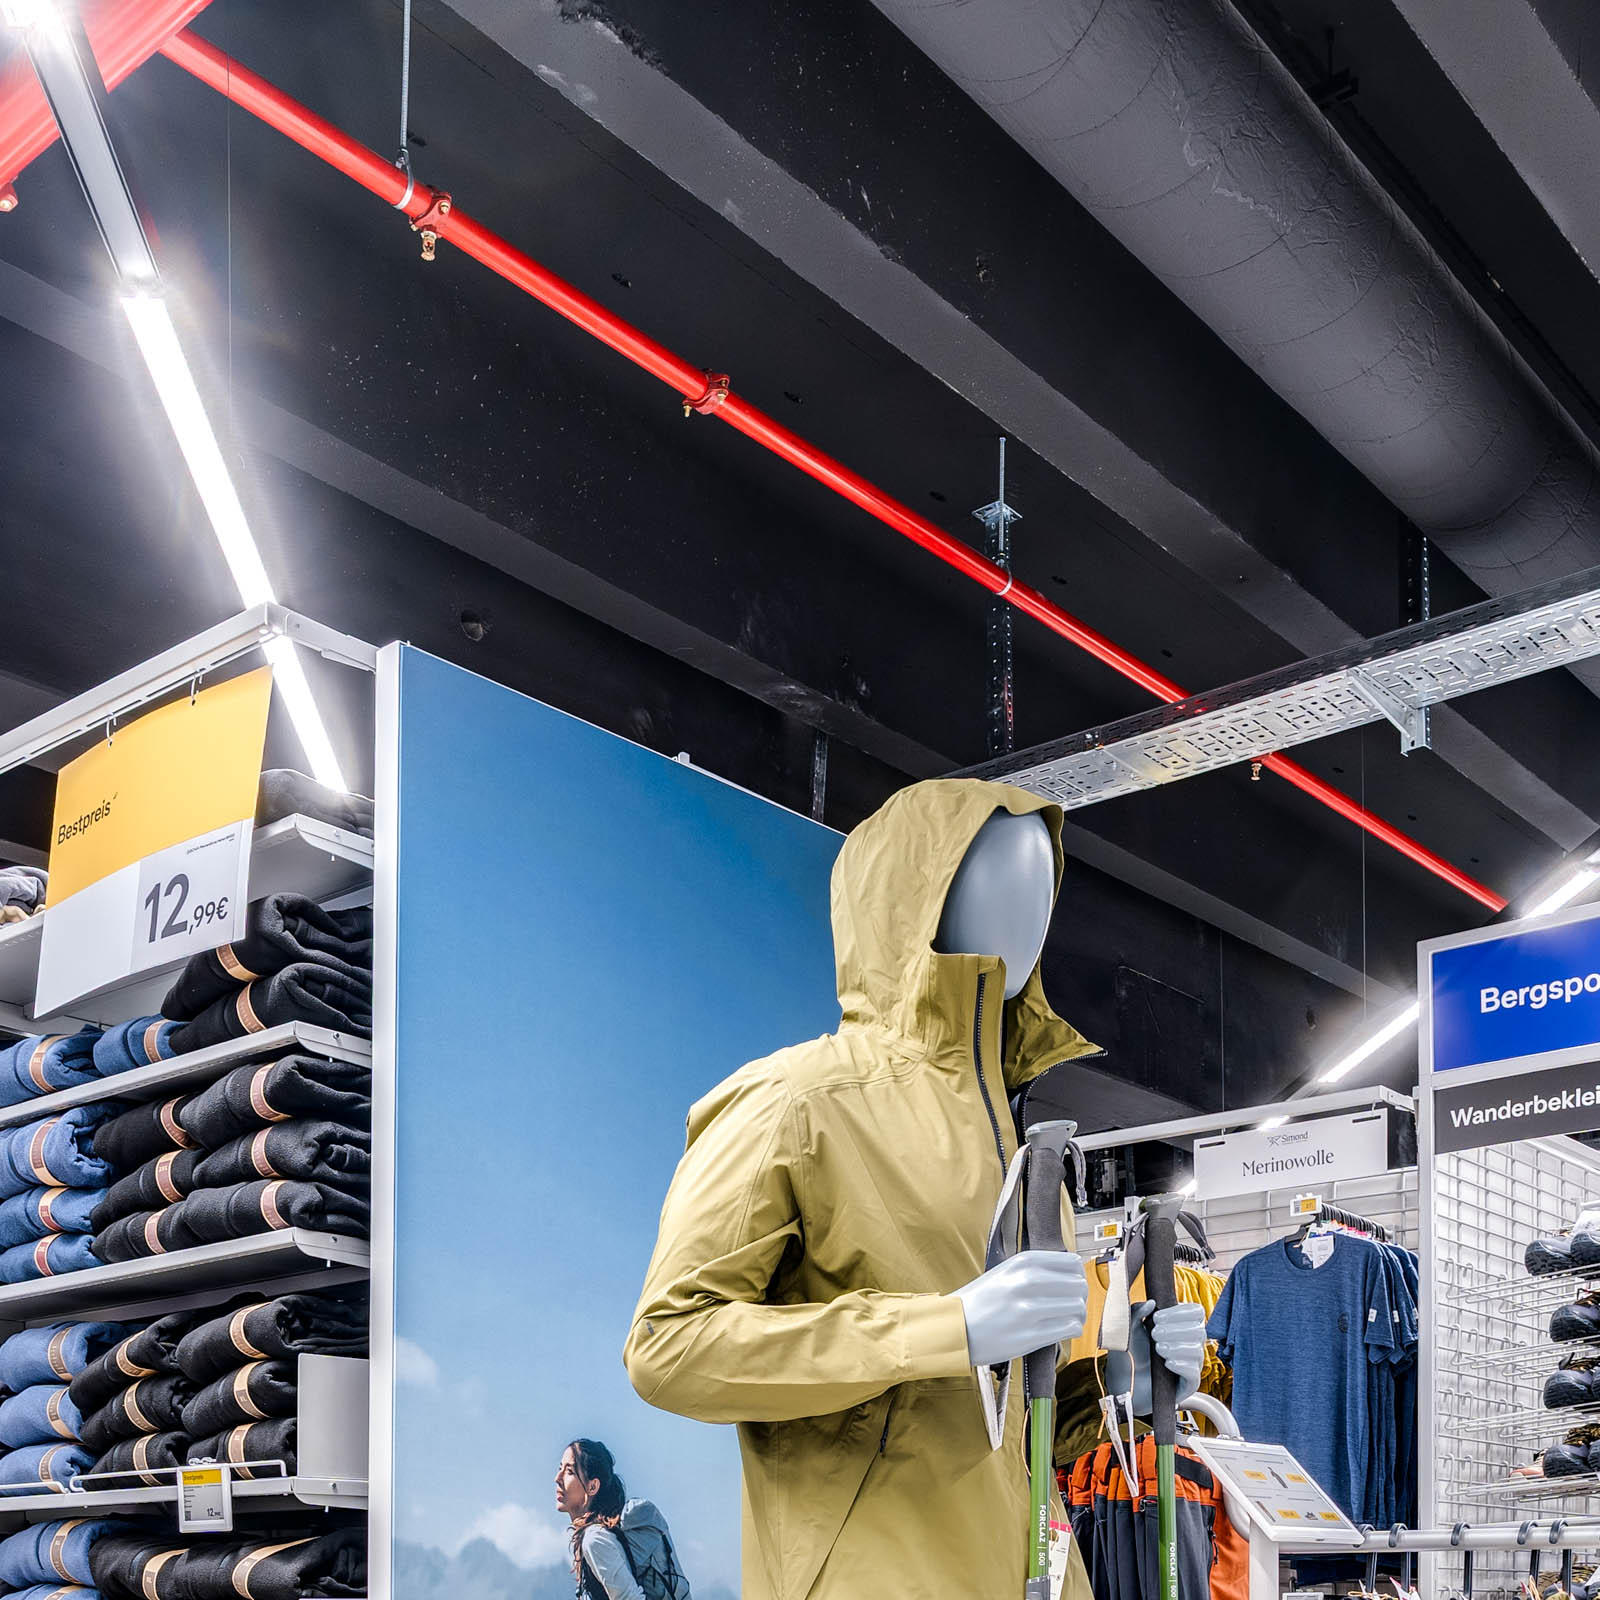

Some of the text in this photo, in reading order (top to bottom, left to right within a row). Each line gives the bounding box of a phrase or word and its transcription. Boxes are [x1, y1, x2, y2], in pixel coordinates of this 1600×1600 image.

[57, 799, 112, 845] Bestpreis
[144, 873, 229, 944] 12,99€
[1281, 1131, 1309, 1144] Simond
[1242, 1150, 1335, 1177] Merinowolle
[1038, 1504, 1047, 1543] FORCLAZ
[1038, 1552, 1046, 1567] 500
[1168, 1541, 1177, 1577] FORCLAZ
